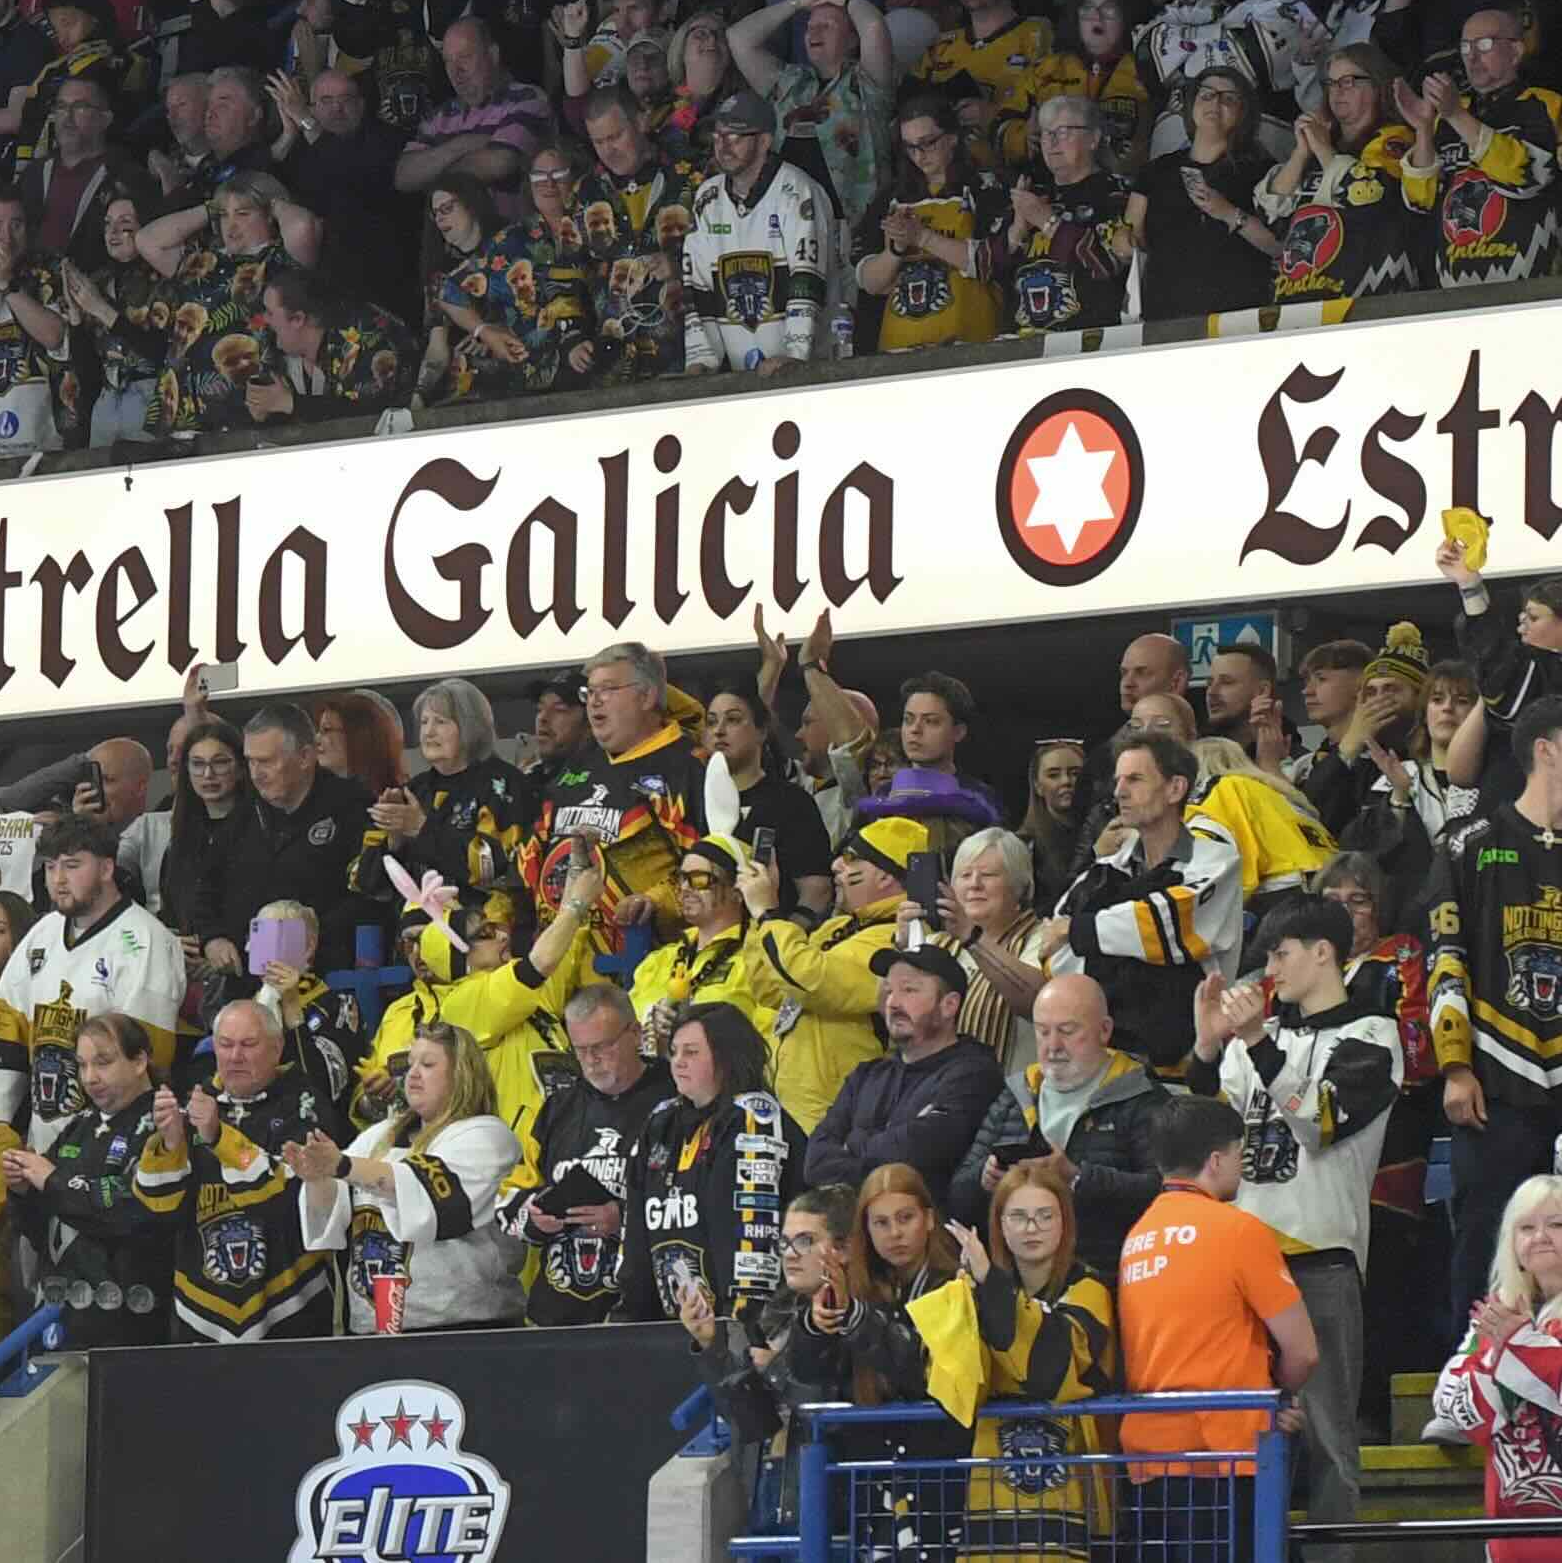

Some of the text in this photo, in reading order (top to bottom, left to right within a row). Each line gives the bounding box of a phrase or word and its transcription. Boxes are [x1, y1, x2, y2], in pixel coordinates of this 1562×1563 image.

[794, 237, 819, 264] 43
[387, 418, 906, 652] Galicia
[644, 1195, 698, 1231] GMB
[743, 1224, 779, 1241] RHPS
[1125, 1225, 1196, 1259] ERE TO
[316, 1486, 494, 1559] ELITE
